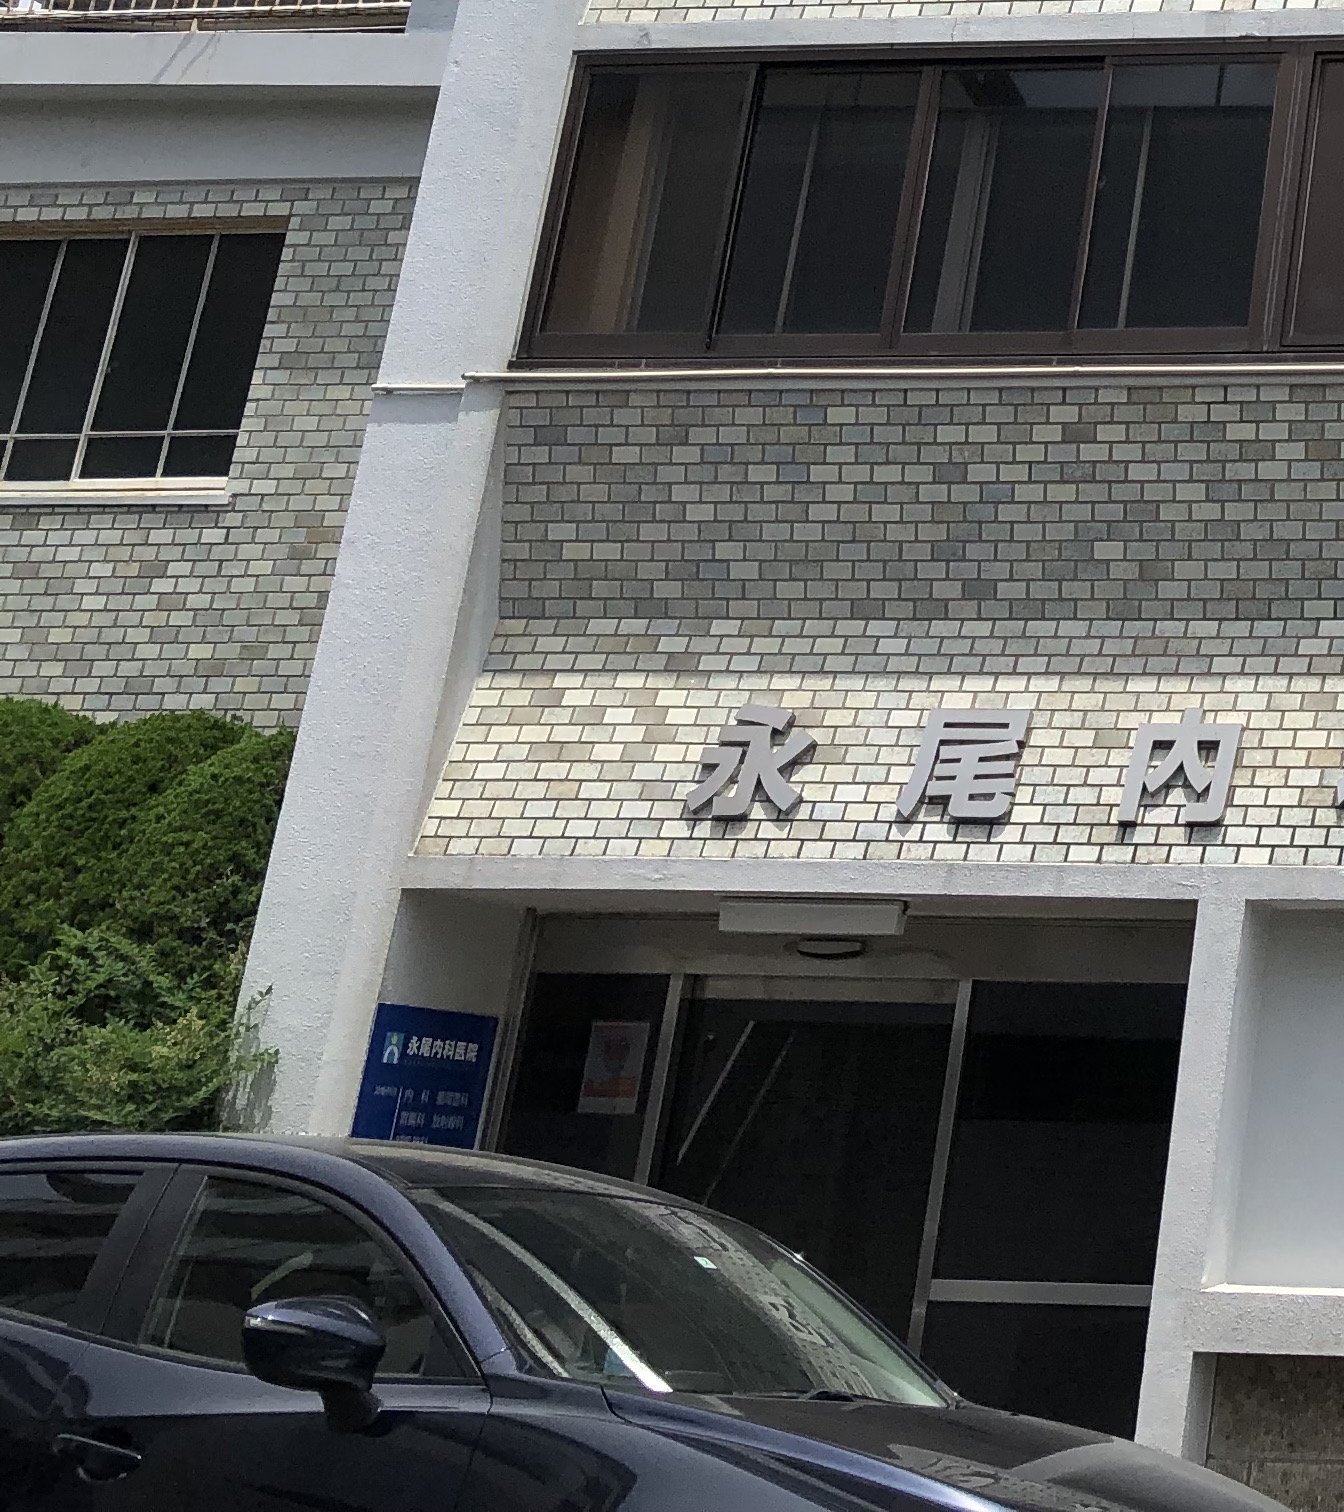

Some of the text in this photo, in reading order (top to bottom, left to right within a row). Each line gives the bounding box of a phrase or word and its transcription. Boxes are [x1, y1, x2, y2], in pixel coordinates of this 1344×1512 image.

[406, 1035, 479, 1063] 永尾内科医院
